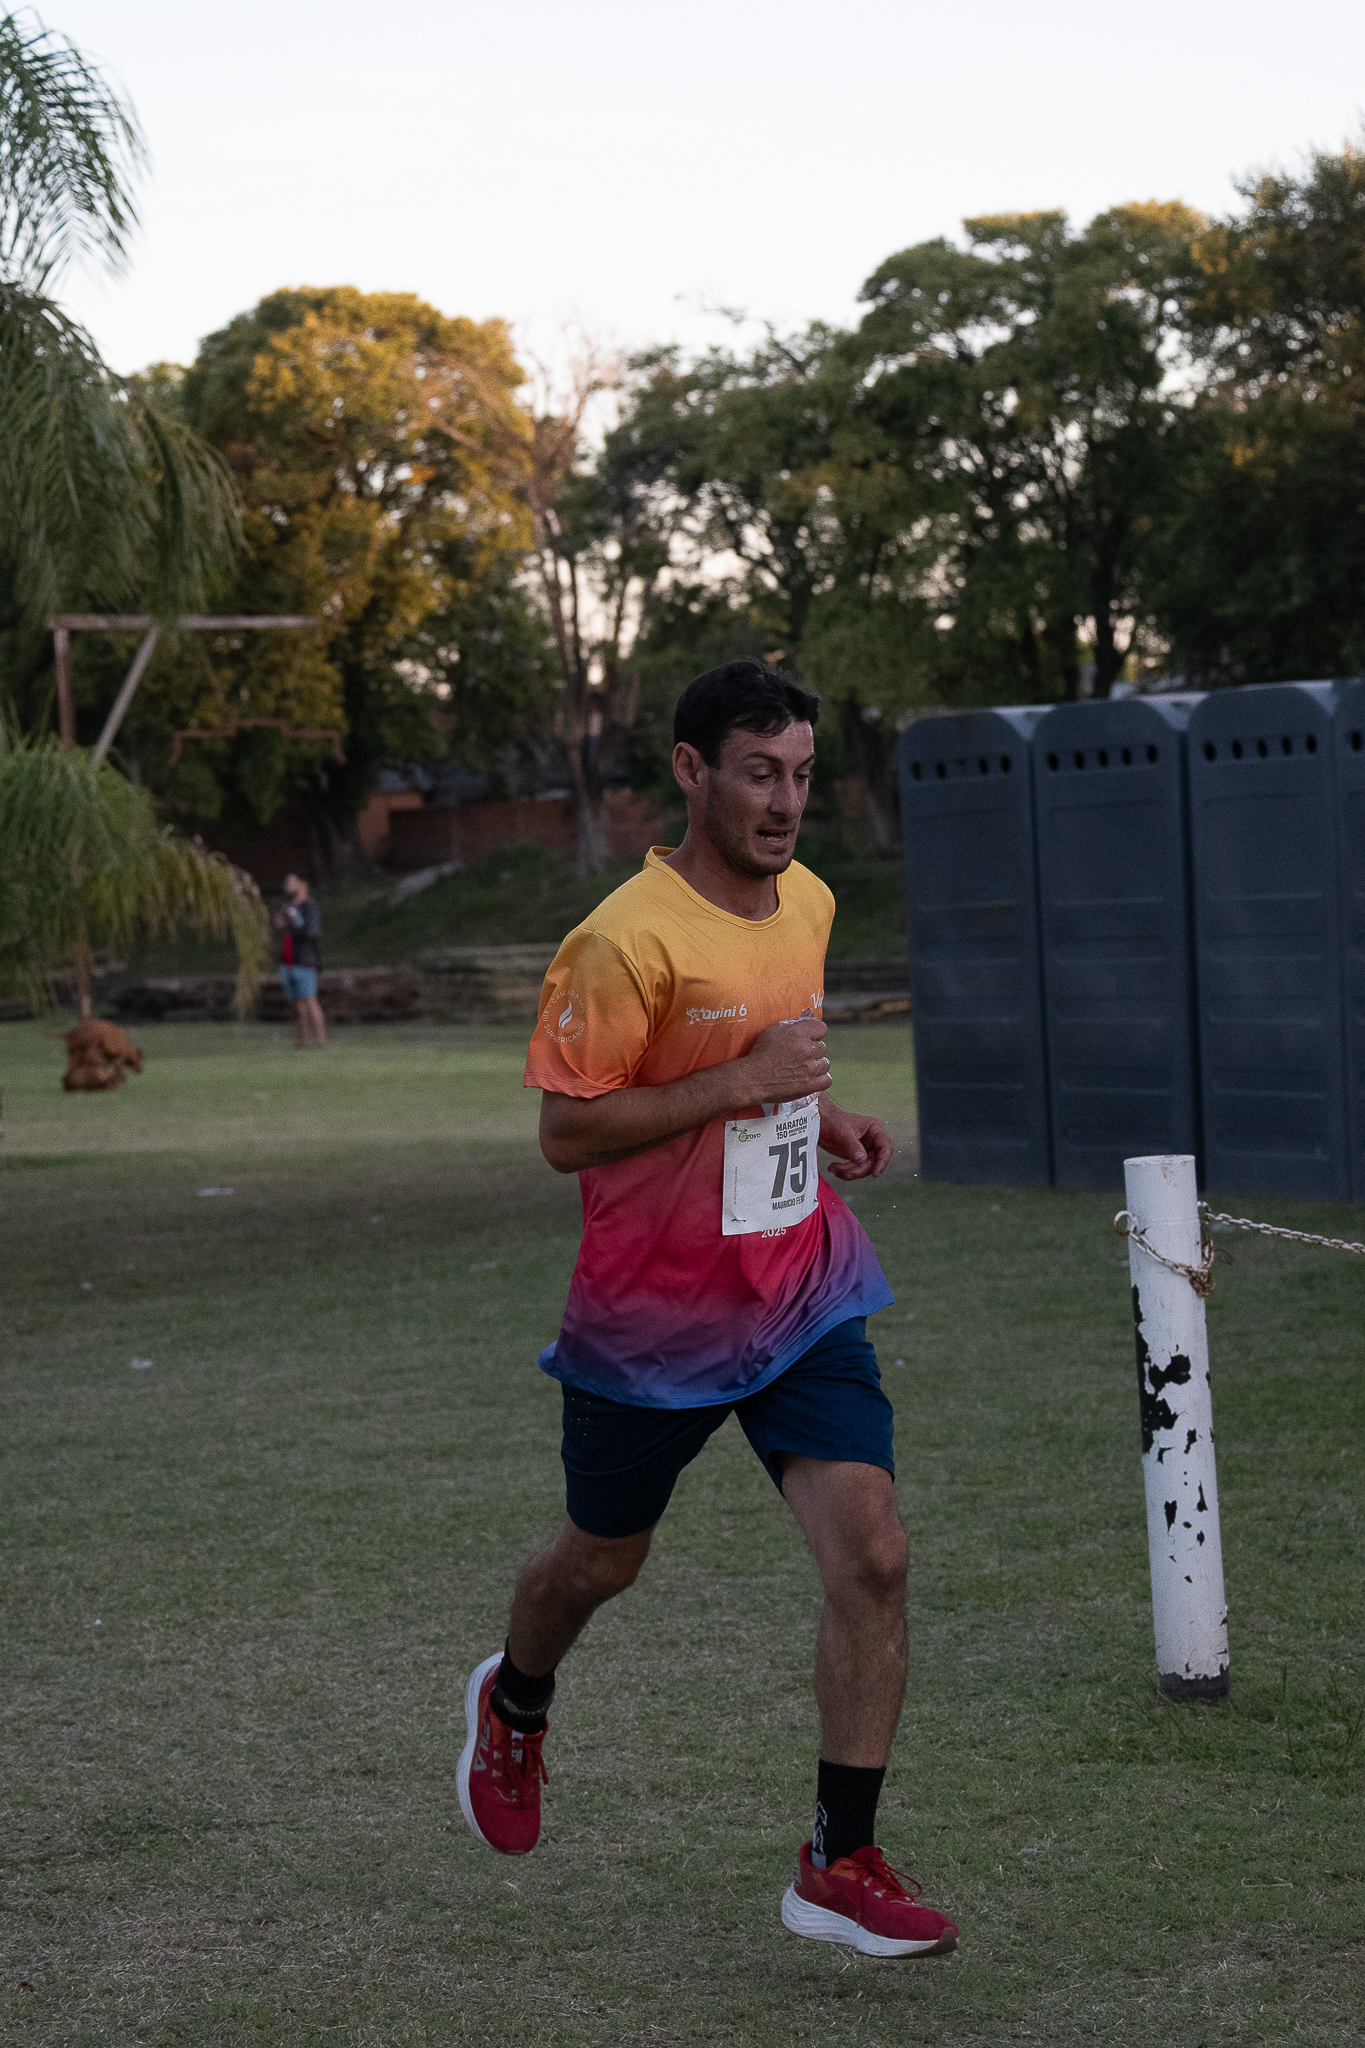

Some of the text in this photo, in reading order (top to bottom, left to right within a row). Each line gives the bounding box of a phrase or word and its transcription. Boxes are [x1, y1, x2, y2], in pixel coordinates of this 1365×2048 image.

[702, 1003, 748, 1020] Quini 6
[776, 1116, 808, 1133] MARATÓN
[776, 1131, 788, 1140] 150
[768, 1136, 808, 1199] 75
[772, 1198, 796, 1211] MAURICIO
[761, 1227, 787, 1239] 2025
